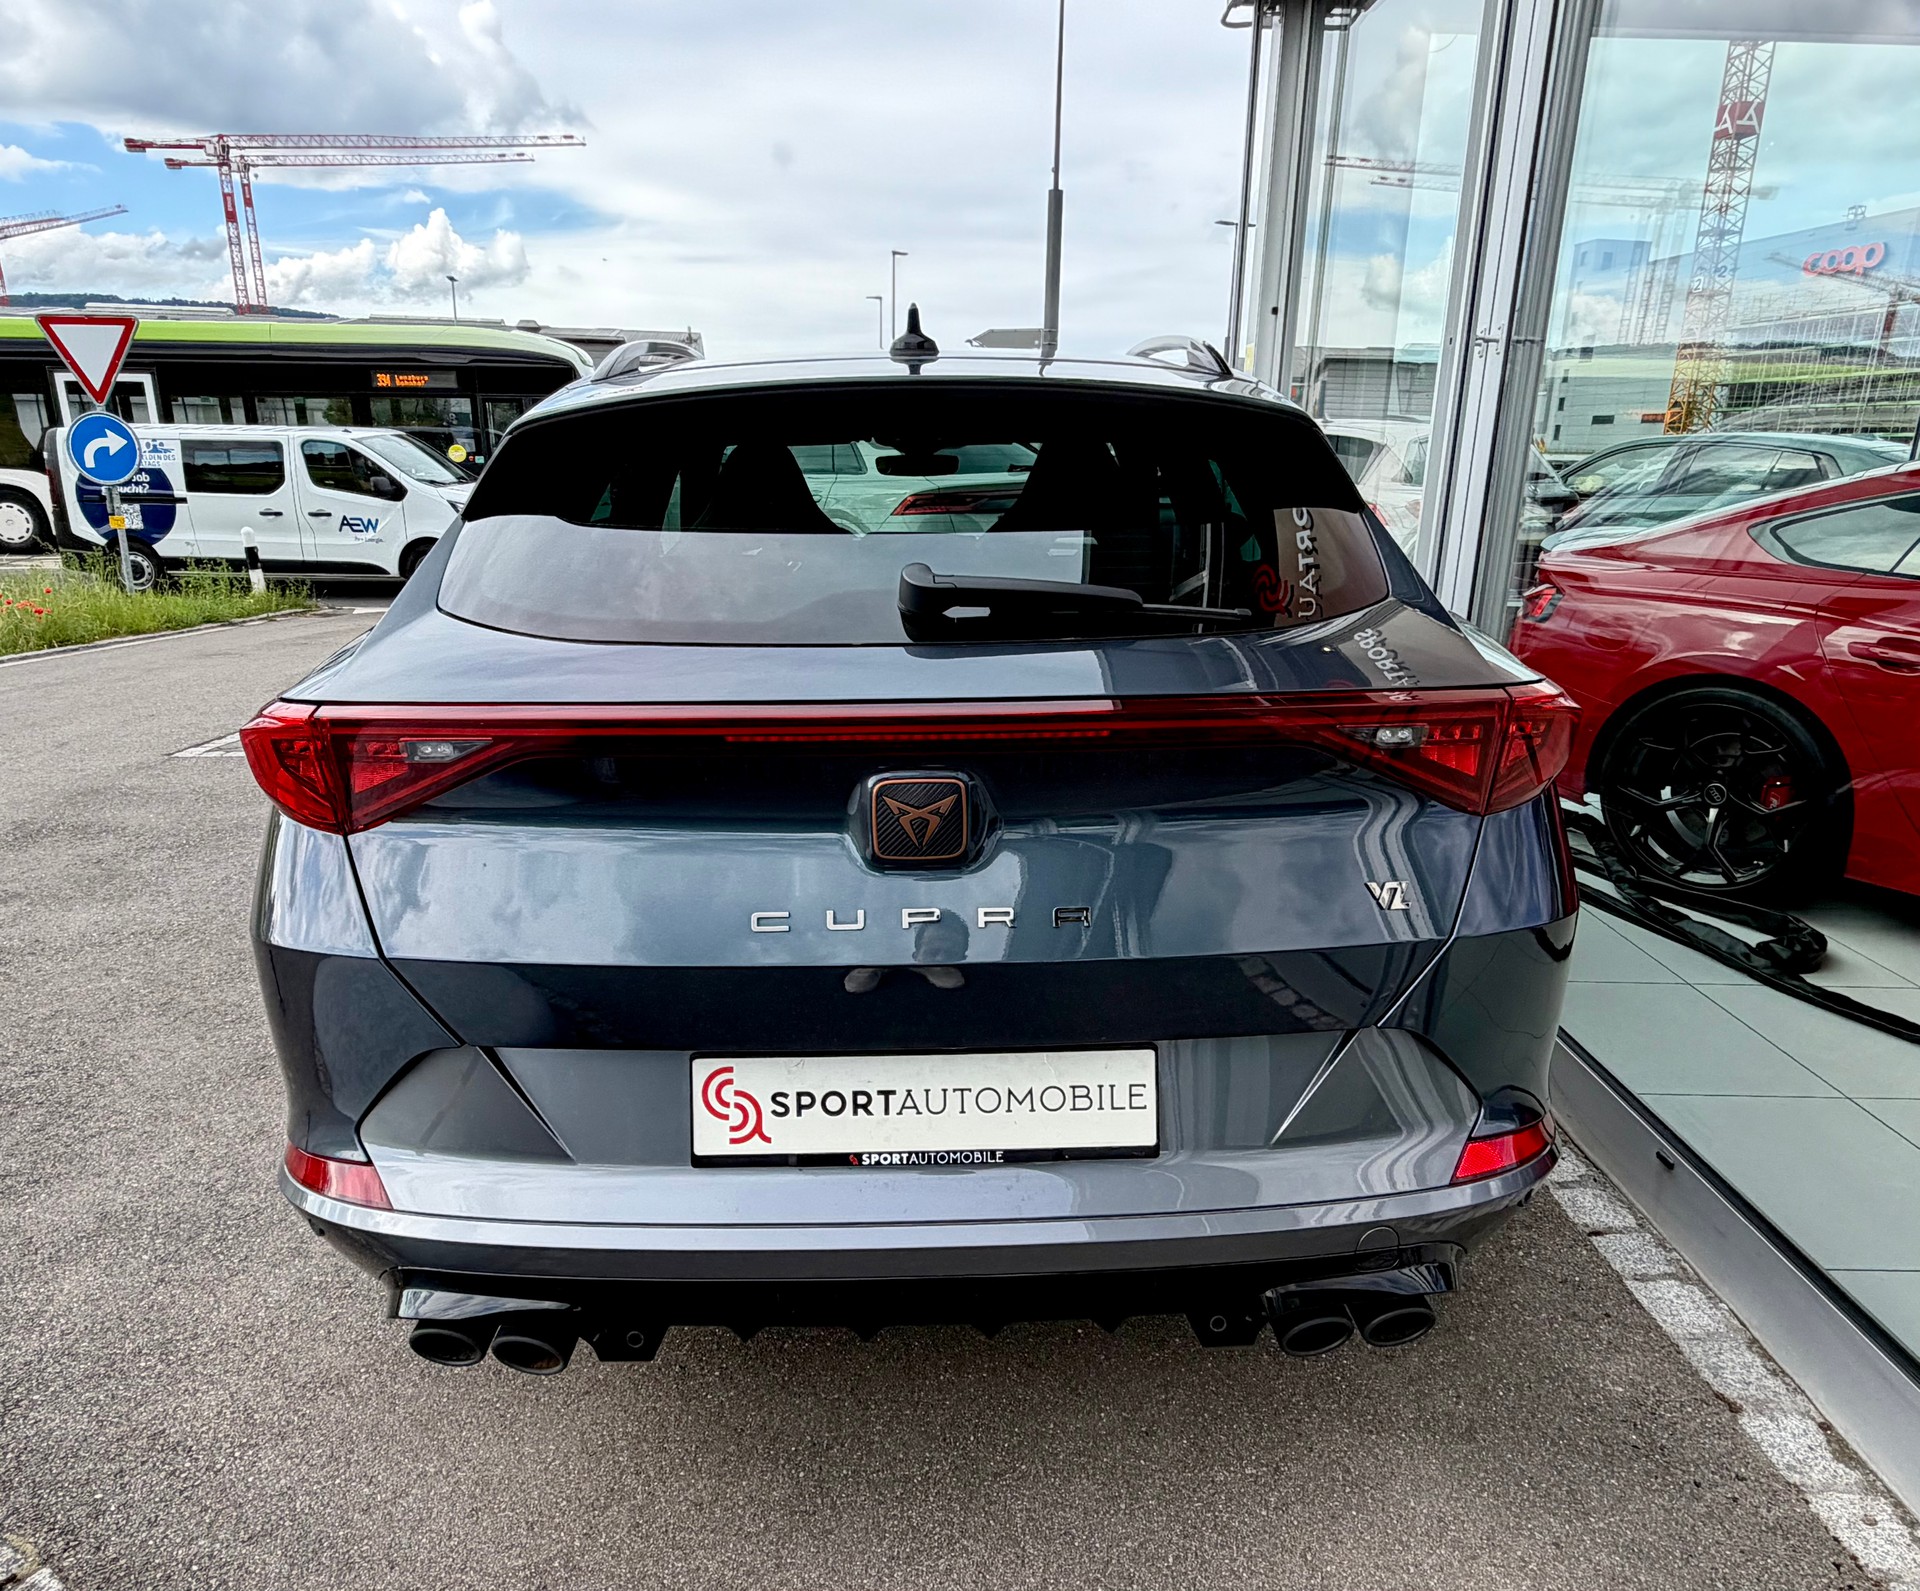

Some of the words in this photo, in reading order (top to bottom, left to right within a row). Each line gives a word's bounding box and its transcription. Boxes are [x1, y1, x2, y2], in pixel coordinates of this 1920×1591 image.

[338, 515, 379, 533] AEW
[750, 907, 1092, 932] CUPRA
[770, 1084, 1147, 1118] SPORTAUTOMOBILE
[861, 1150, 1004, 1166] SPORTAUTOMOBILE
